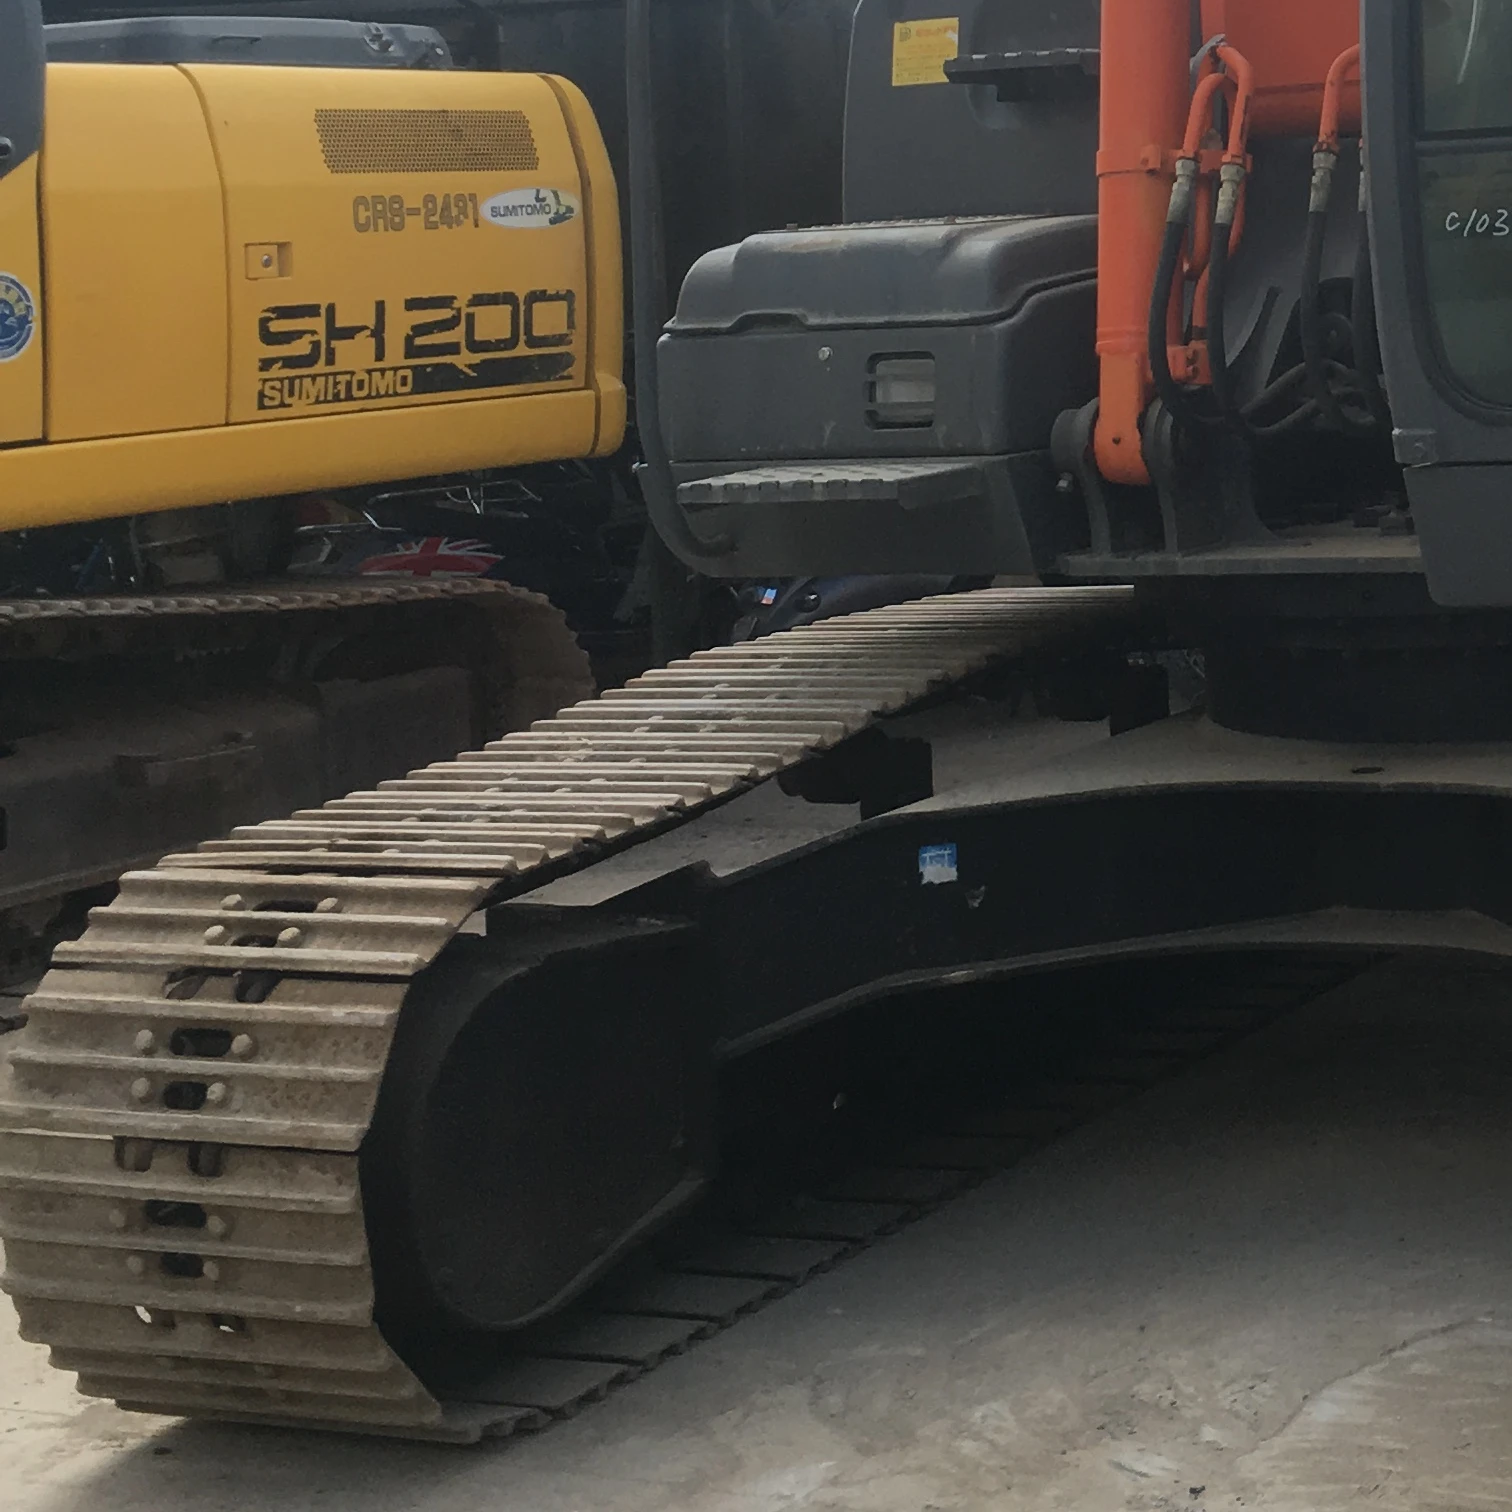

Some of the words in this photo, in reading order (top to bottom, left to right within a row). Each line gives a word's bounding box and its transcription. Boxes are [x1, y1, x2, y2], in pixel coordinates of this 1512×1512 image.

[490, 203, 552, 218] SUMITOMO
[258, 299, 386, 372] SH
[403, 289, 576, 360] 200
[262, 369, 413, 407] SUMITOMO
